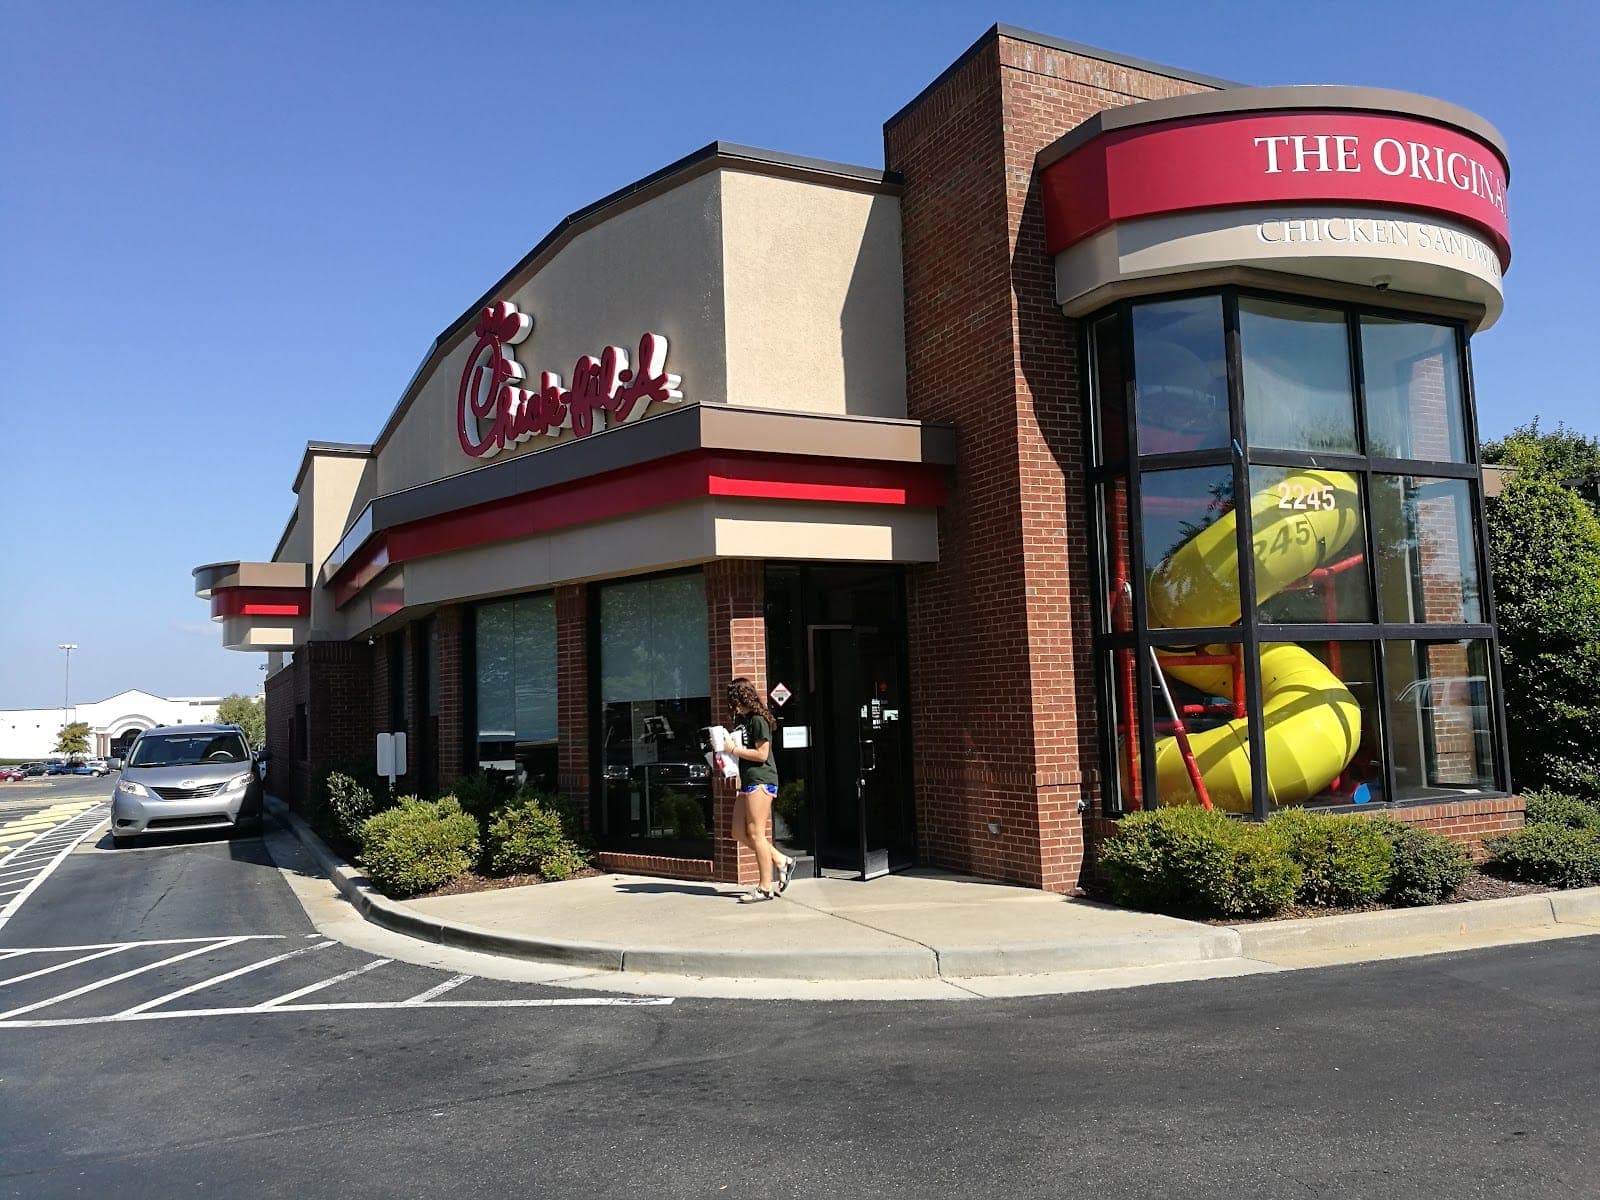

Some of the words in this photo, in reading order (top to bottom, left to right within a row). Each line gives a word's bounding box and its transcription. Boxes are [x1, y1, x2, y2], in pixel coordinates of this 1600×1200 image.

[1253, 134, 1362, 175] THE
[1372, 137, 1508, 220] ORIGINA
[1255, 216, 1410, 248] CHICKEN
[1277, 482, 1336, 511] 2245
